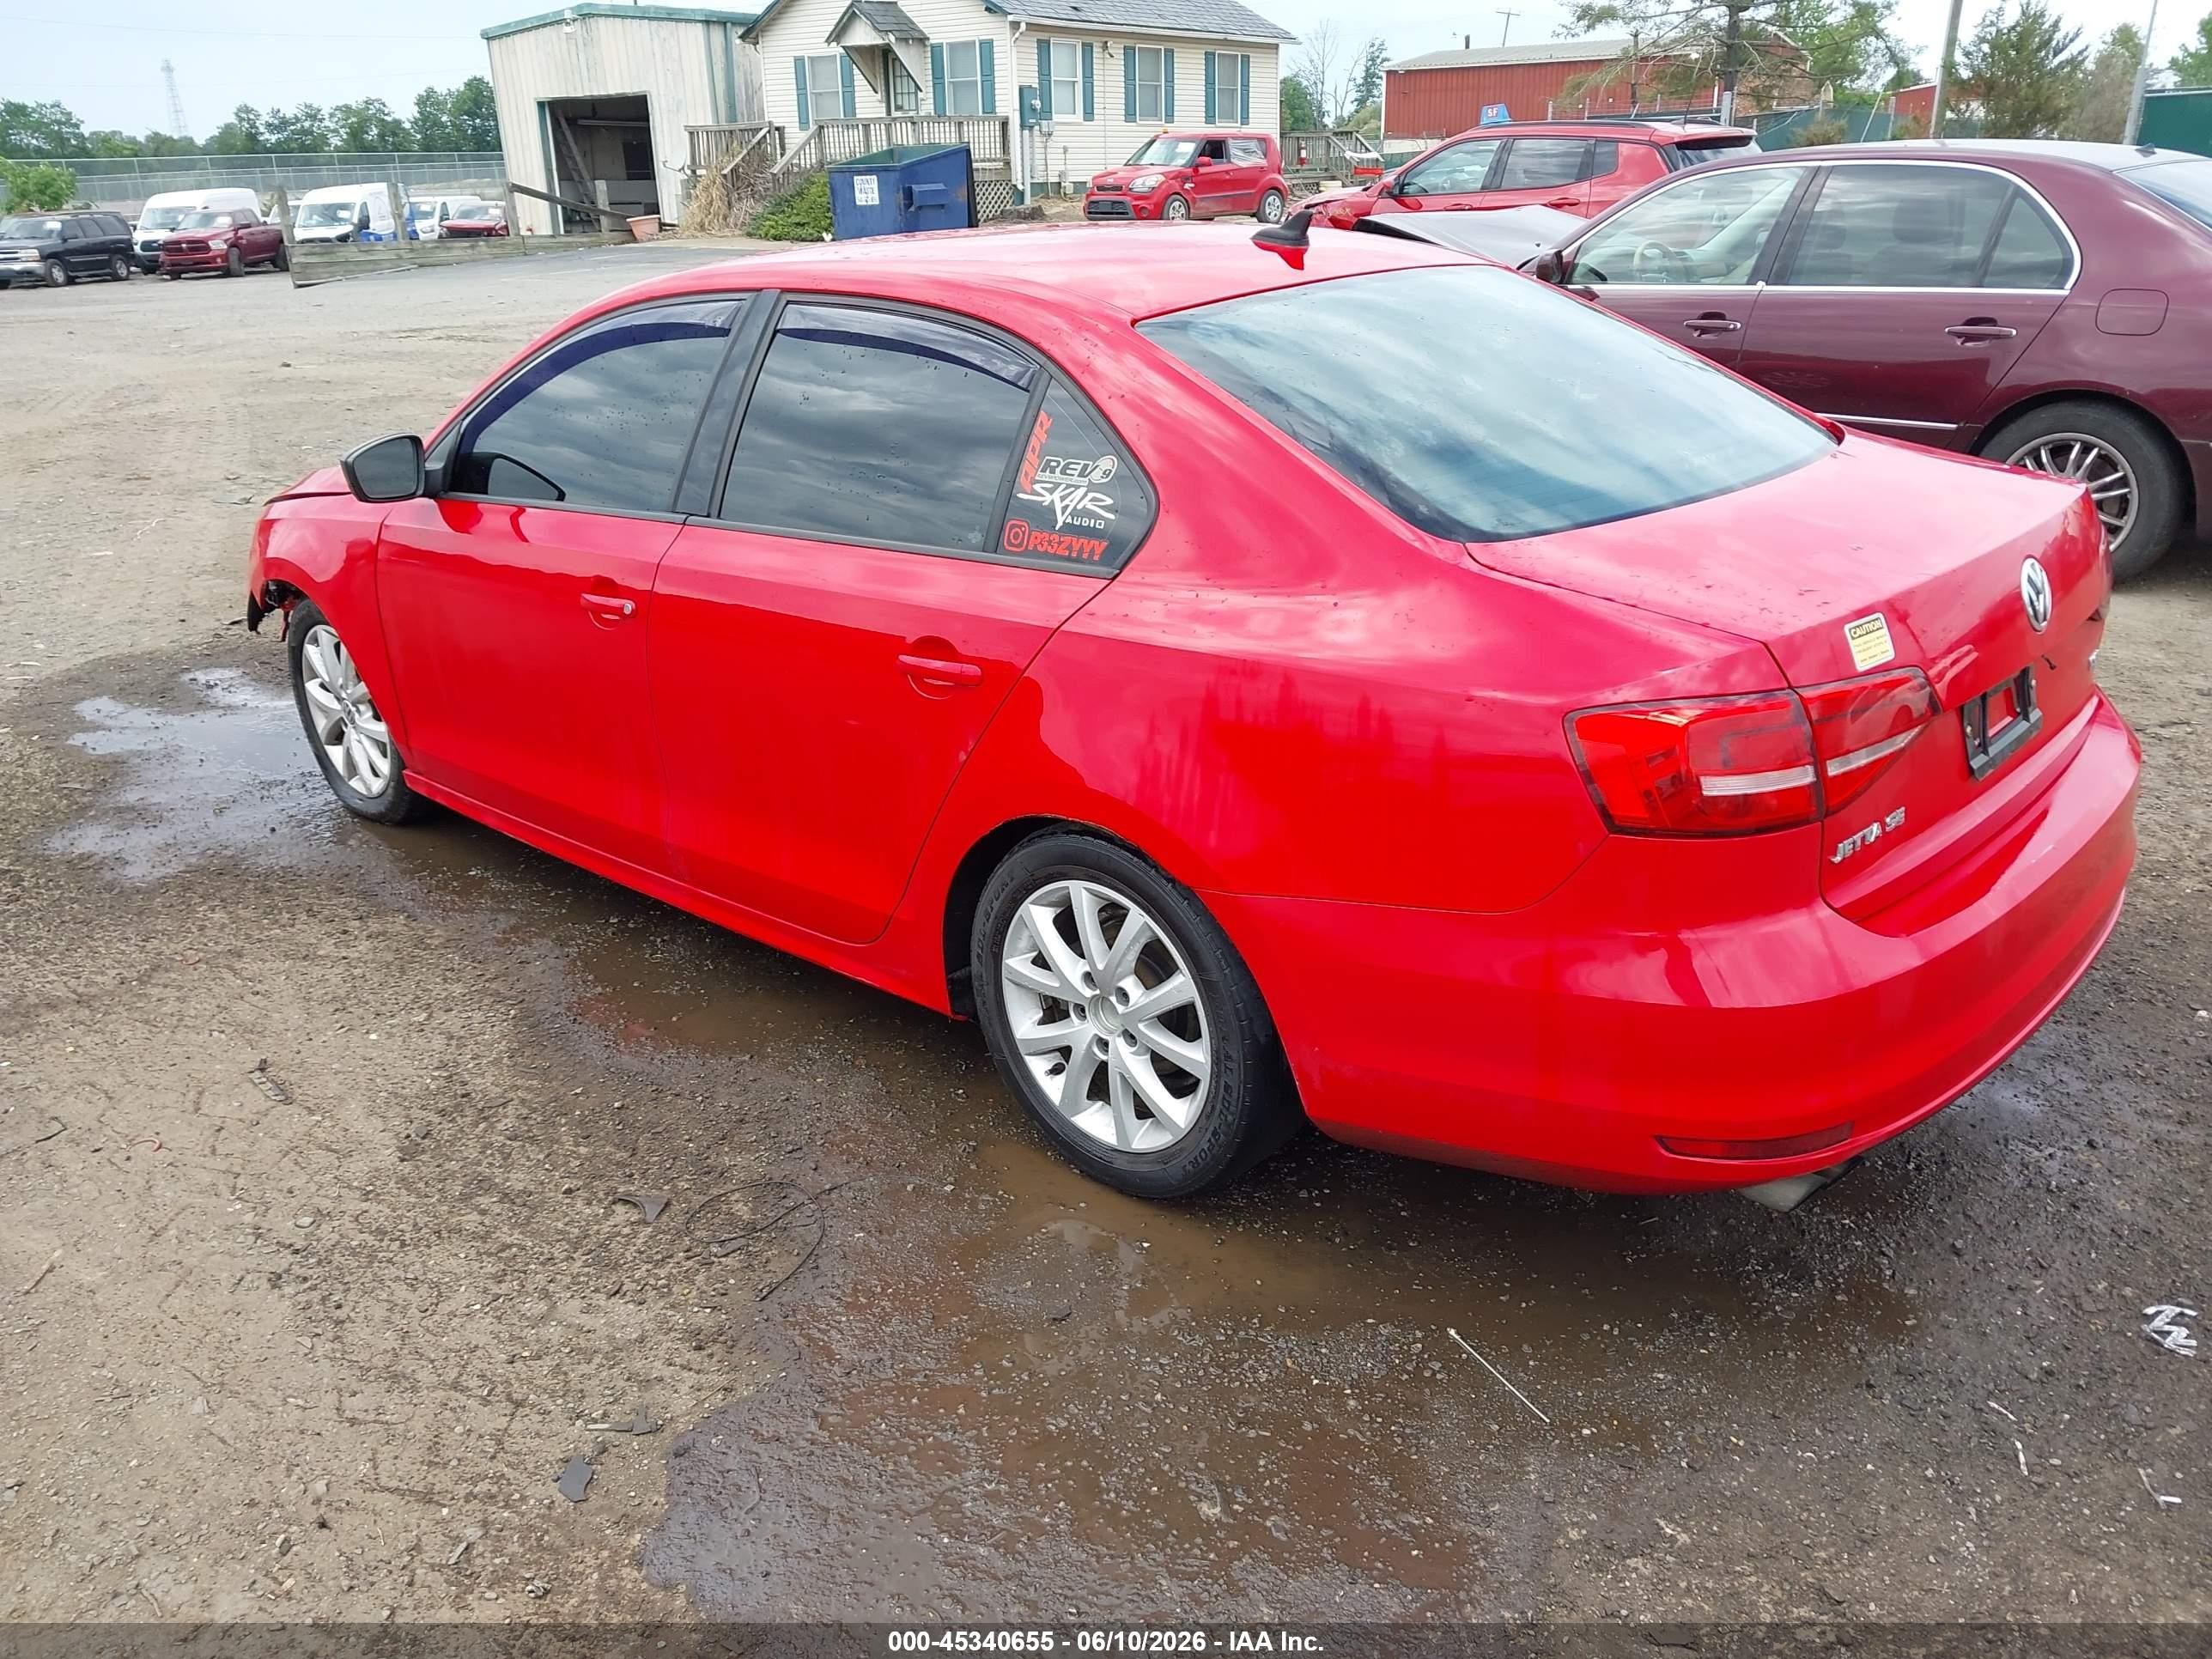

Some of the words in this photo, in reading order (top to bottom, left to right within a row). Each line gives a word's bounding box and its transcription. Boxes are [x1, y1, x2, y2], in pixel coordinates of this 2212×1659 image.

[1016, 483, 1115, 531] SKAR
[1066, 515, 1104, 528] AUDIO
[1850, 618, 1883, 639] CAUTION
